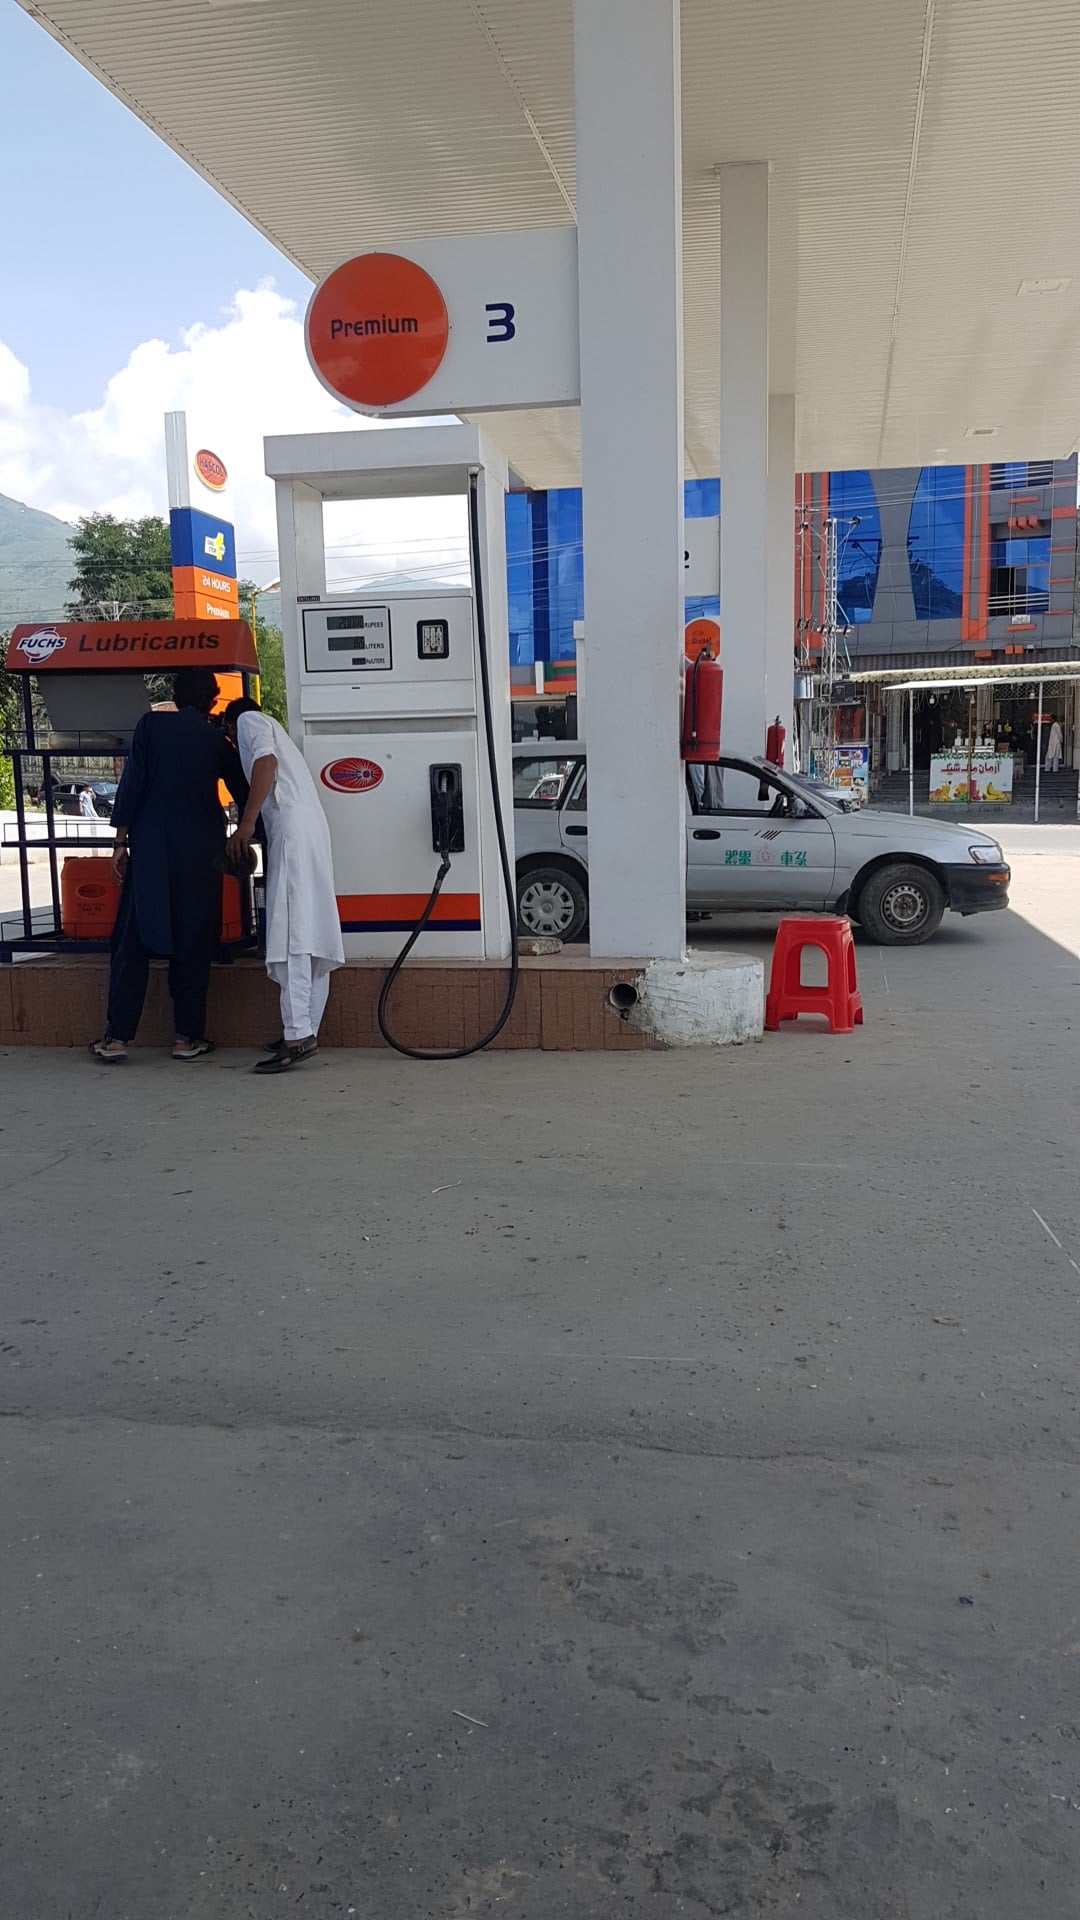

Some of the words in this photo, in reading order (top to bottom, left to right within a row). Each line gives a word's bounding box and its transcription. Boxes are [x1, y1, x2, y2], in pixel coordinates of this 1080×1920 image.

[330, 313, 419, 340] Premium
[484, 301, 517, 344] 3
[202, 575, 211, 588] 24
[211, 578, 231, 593] HOURS
[206, 602, 230, 618] Premium
[19, 638, 66, 649] FUCHS
[78, 631, 220, 653] Lubricants
